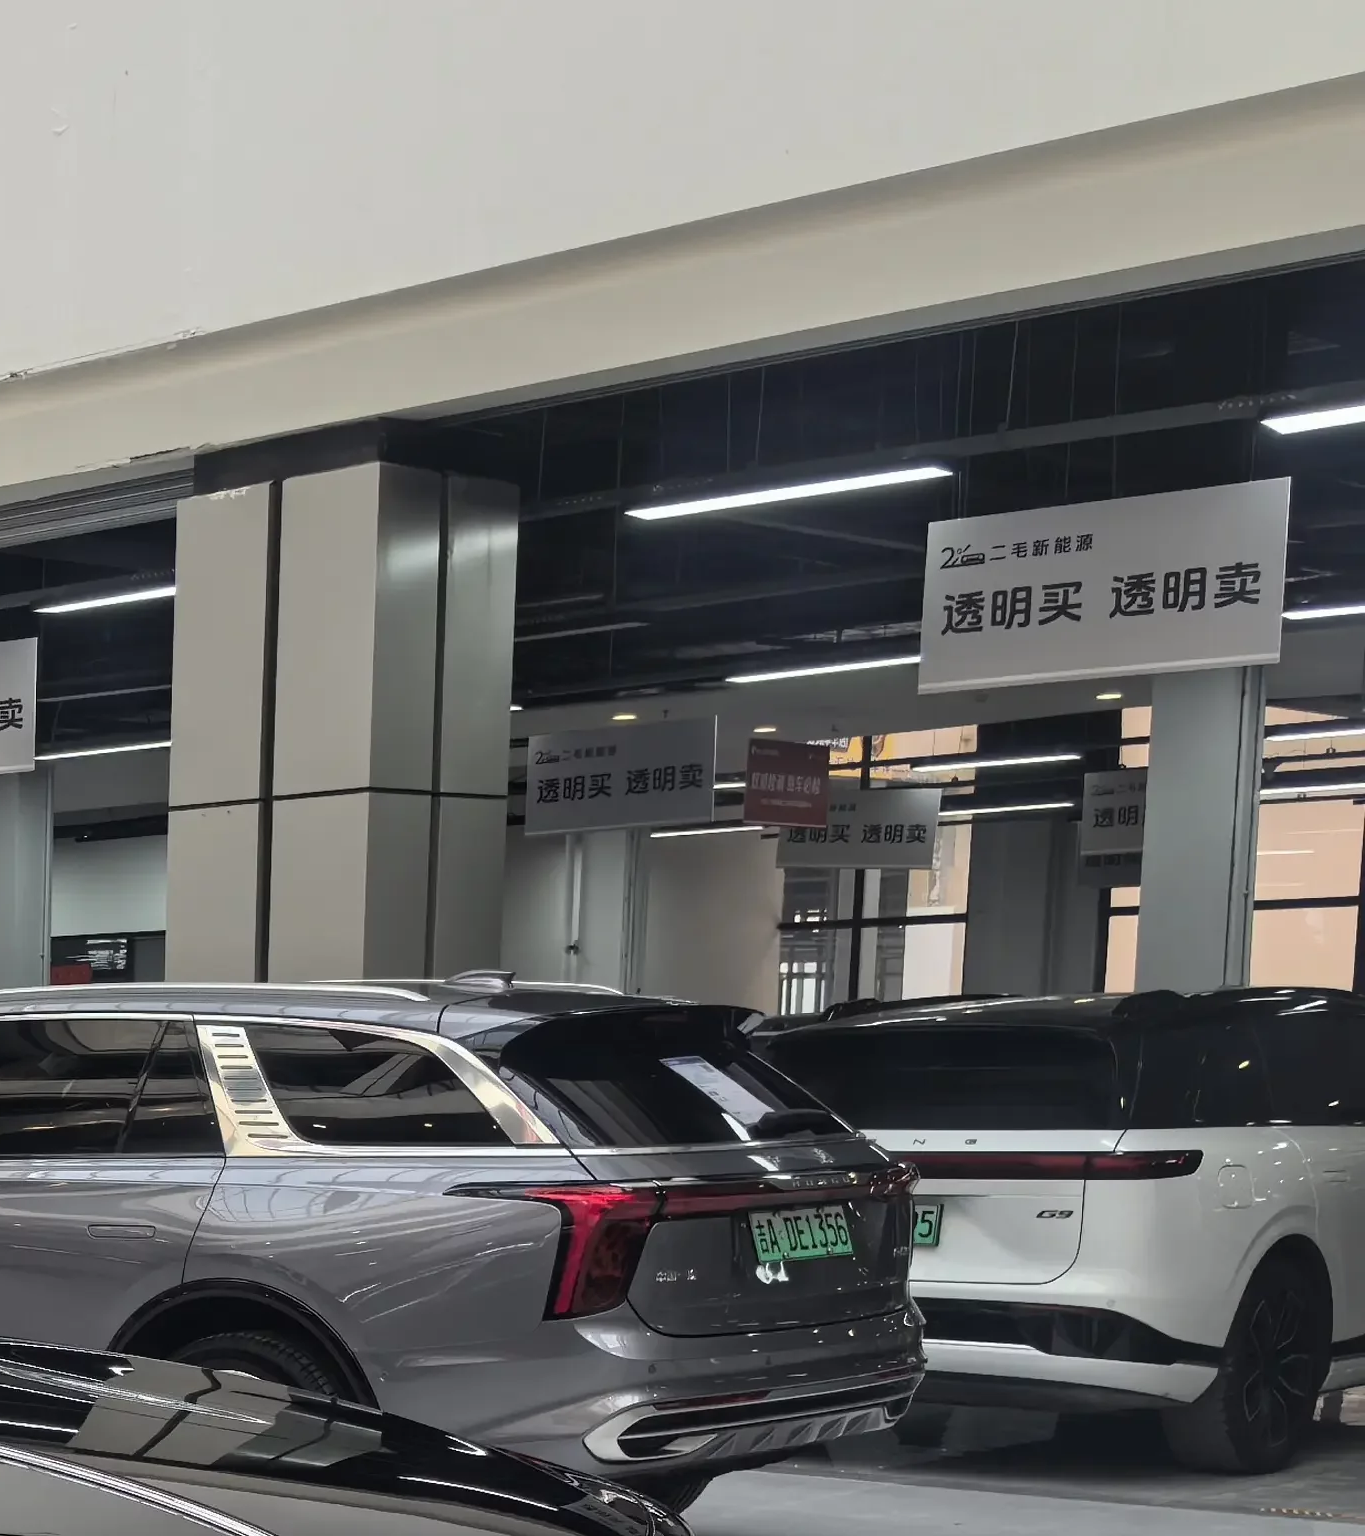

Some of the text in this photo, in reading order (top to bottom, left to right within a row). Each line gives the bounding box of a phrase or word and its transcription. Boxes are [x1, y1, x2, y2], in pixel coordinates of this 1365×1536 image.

[989, 533, 1094, 562] 二毛新能源
[940, 561, 1262, 636] 透明买 透明卖
[536, 763, 704, 804] 透明买 透明卖
[861, 823, 928, 845] 透明卖
[1035, 1209, 1074, 1220] G9
